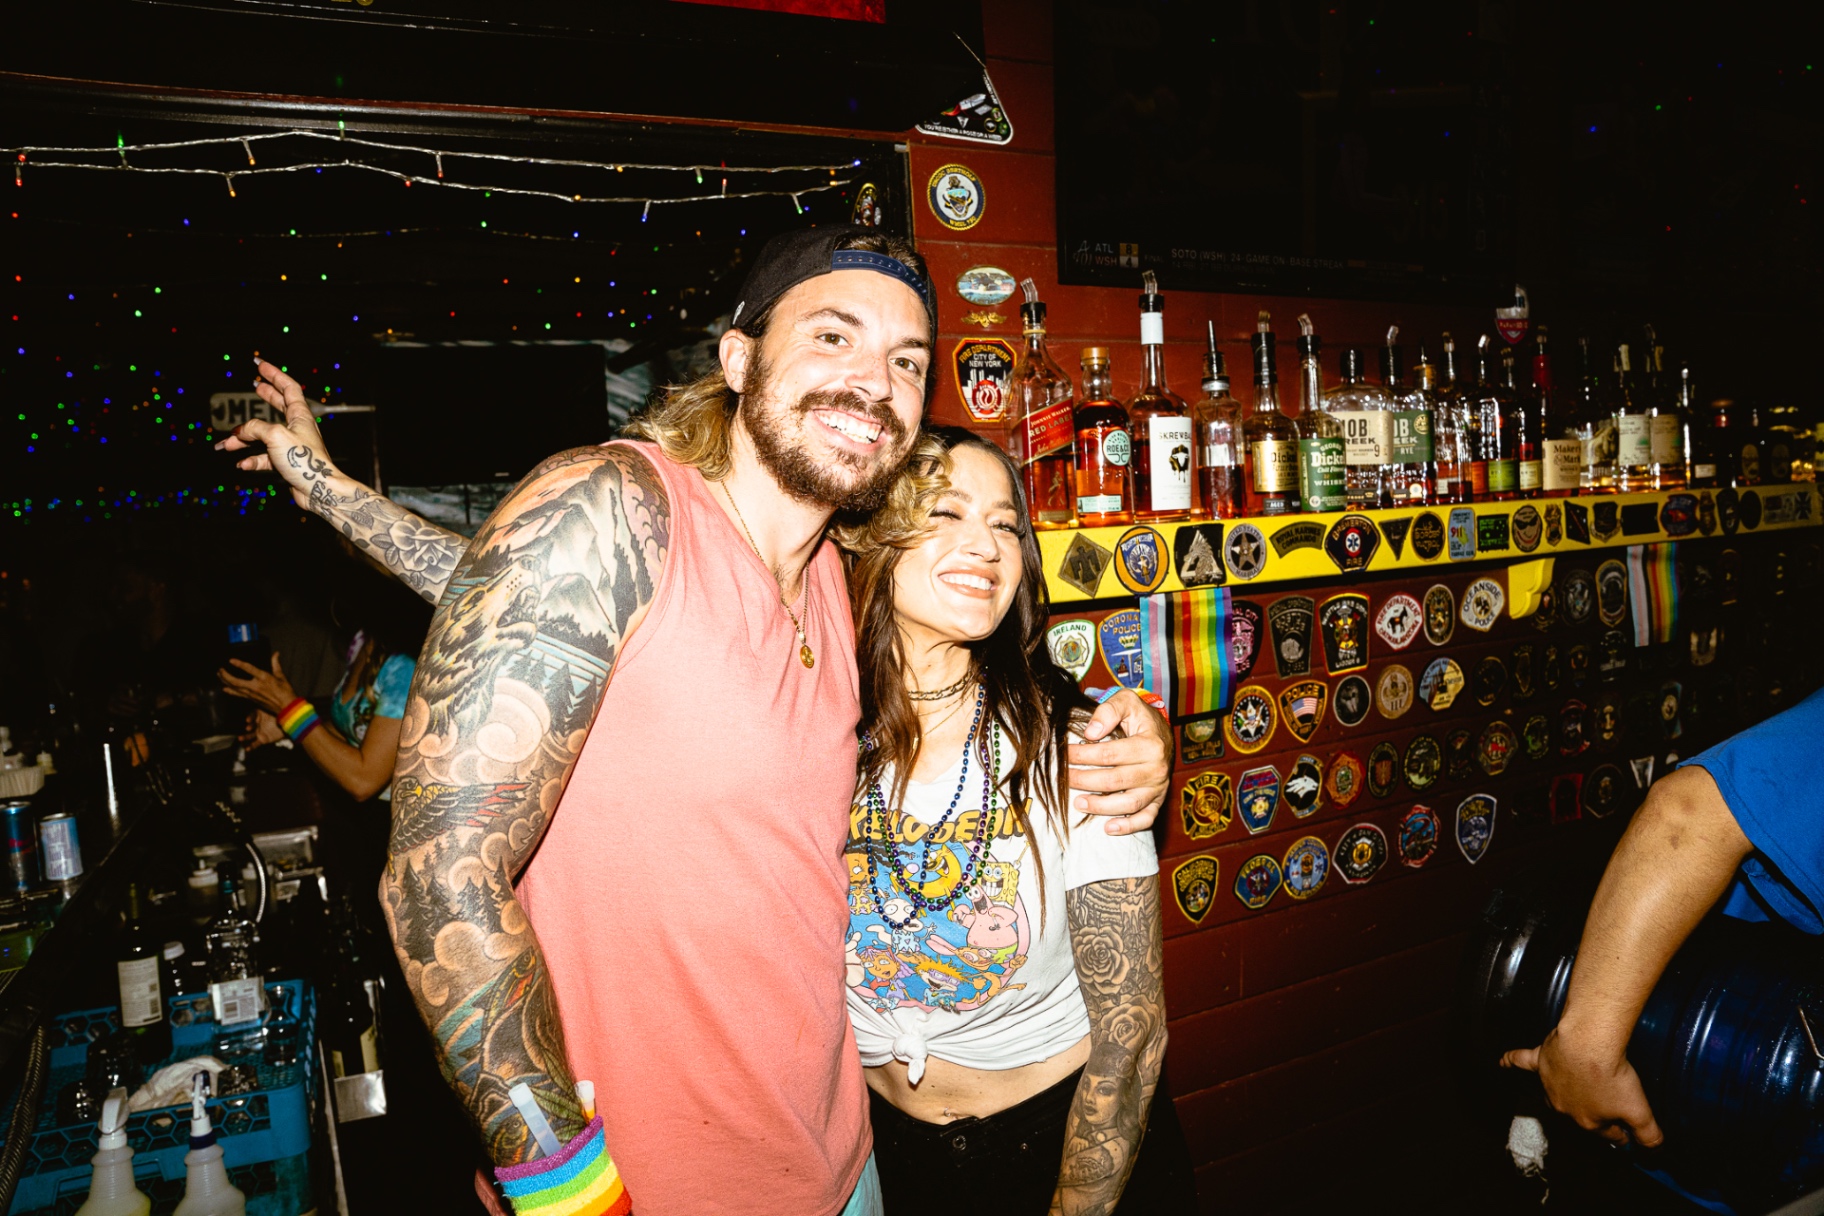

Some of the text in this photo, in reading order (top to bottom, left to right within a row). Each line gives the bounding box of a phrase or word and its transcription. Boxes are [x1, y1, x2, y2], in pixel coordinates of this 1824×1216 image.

[1094, 242, 1114, 254] ATL
[1094, 255, 1118, 266] WSH
[1171, 248, 1197, 259] SOTO
[1313, 258, 1344, 270] STREAK
[958, 344, 1012, 363] FIRE DEPARTMENT
[973, 353, 997, 361] CITY OF
[969, 360, 1002, 368] NEW YORK
[1029, 425, 1047, 437] RED
[1048, 413, 1073, 428] LABEL
[1030, 415, 1051, 428] JOHNNIE
[1345, 437, 1376, 445] REEK
[1374, 444, 1381, 457] 9
[1400, 446, 1414, 455] RYE
[1241, 525, 1262, 541] STATES
[1275, 526, 1321, 544] ROYAL MARINES
[1331, 518, 1372, 541] BREMERTON
[1414, 527, 1441, 539] BORDER
[1450, 526, 1463, 538] 911
[1281, 535, 1316, 550] COMMANDO
[1415, 539, 1440, 551] PATROL
[1346, 557, 1362, 567] FIRE
[1463, 582, 1502, 613] OCEANSIDE
[1245, 608, 1259, 622] CITY
[1321, 601, 1341, 626] SEATTLE
[1377, 607, 1387, 626] FIRE
[1387, 596, 1421, 618] DEPARTMENT
[1474, 611, 1496, 628] POLICE
[1053, 624, 1087, 637] IRELAND
[1112, 623, 1141, 635] POLICE
[1335, 659, 1355, 669] LADDER
[1285, 684, 1320, 702] POLICE
[1194, 775, 1219, 789] FIRE
[1240, 857, 1277, 879] FEDERAL
[1249, 895, 1267, 905] FIRE
